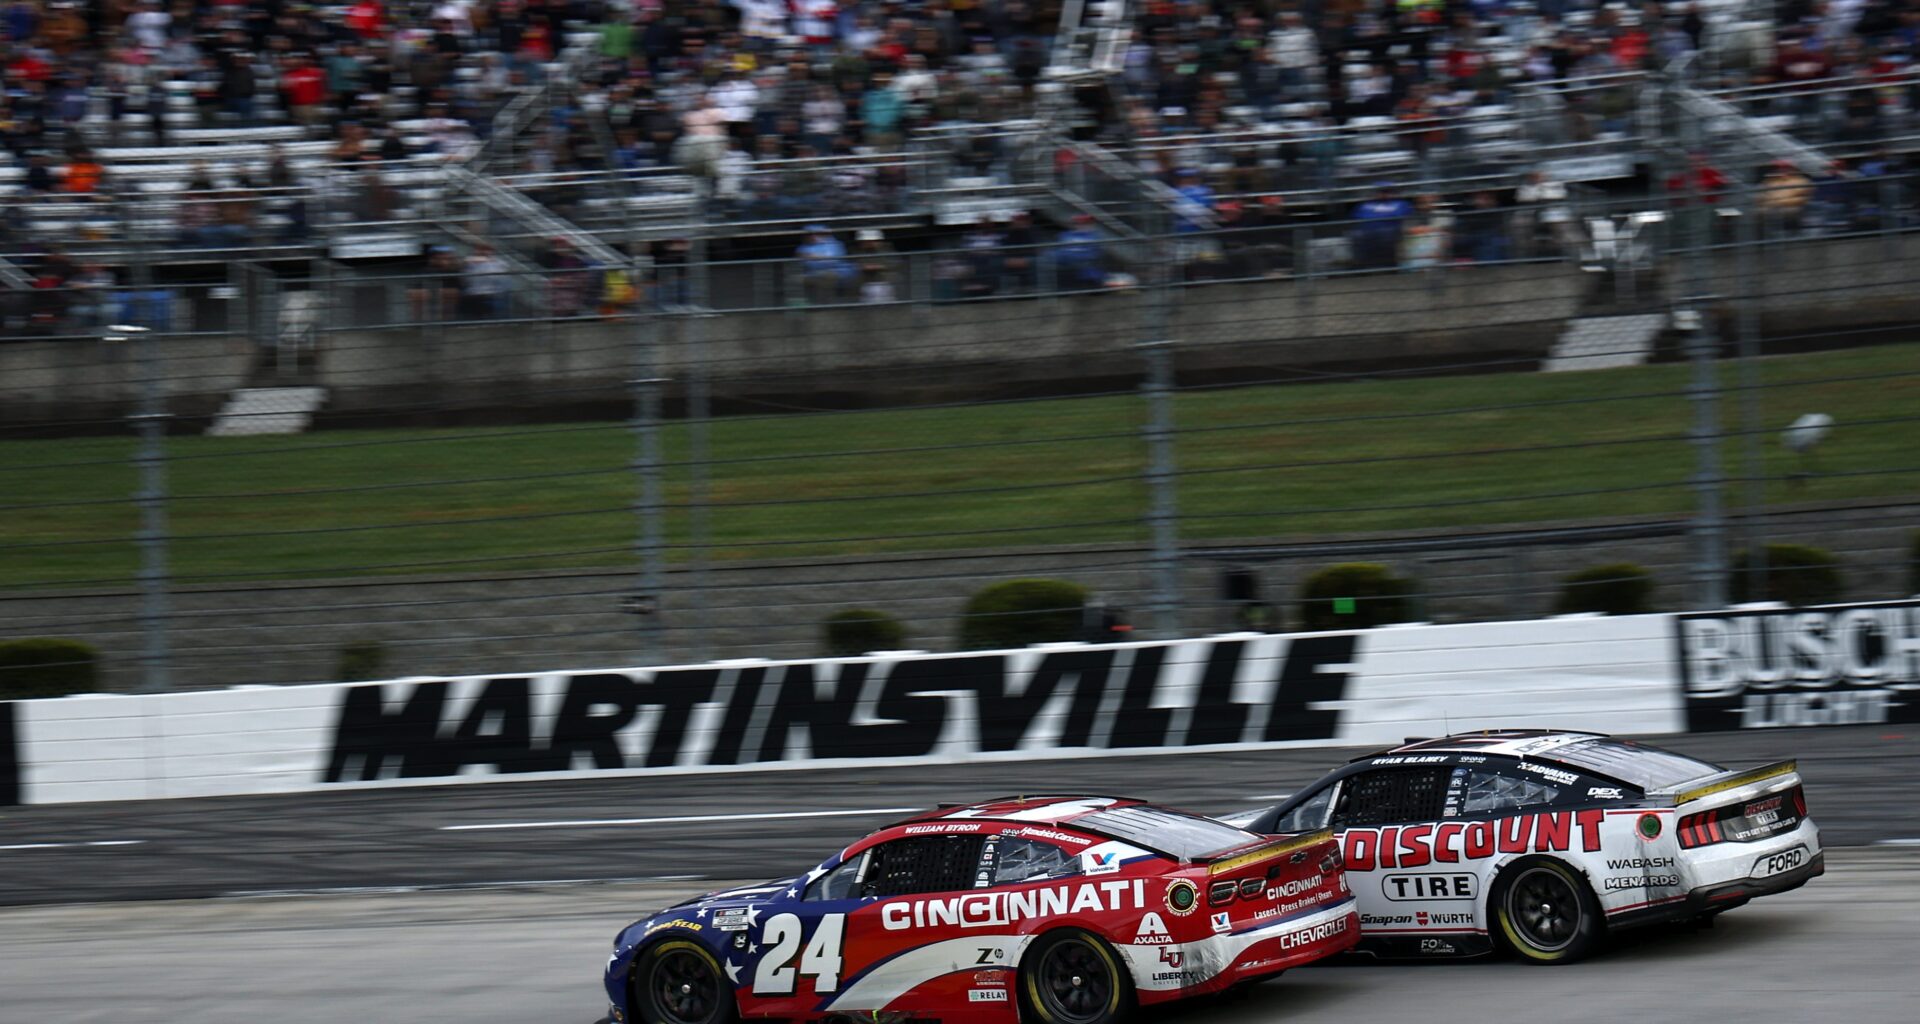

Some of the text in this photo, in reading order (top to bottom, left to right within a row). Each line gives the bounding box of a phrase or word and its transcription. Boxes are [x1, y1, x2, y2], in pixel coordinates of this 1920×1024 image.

[1683, 610, 1920, 698] BUSCH
[324, 636, 1356, 783] MARTINSVILLE
[1371, 757, 1403, 765] RYAN
[1528, 764, 1579, 781] ADVANCE
[1587, 787, 1622, 796] DEX
[1759, 812, 1777, 823] TIRE
[905, 824, 981, 834] WILLIAM BYRON
[1343, 808, 1605, 872] DISCOUNT
[1607, 857, 1674, 870] WABASH
[1768, 850, 1802, 874] FORD
[1267, 875, 1322, 900] CINCINNATI
[1391, 877, 1471, 898] TIRE
[1605, 875, 1679, 889] MENARDS
[881, 879, 1145, 931] CINCINNATI
[1254, 908, 1277, 919] Lasers
[1281, 902, 1298, 913] Press
[1298, 896, 1316, 908] Brakes
[1360, 913, 1474, 926] Snap-on WÜRTH
[1133, 935, 1173, 944] AXALTA
[1280, 917, 1347, 950] CHEVROLET
[753, 913, 845, 994] 24
[976, 948, 994, 964] Z
[1158, 946, 1184, 968] LU
[1152, 971, 1194, 980] LIBERTY
[980, 991, 1005, 999] RELAY
